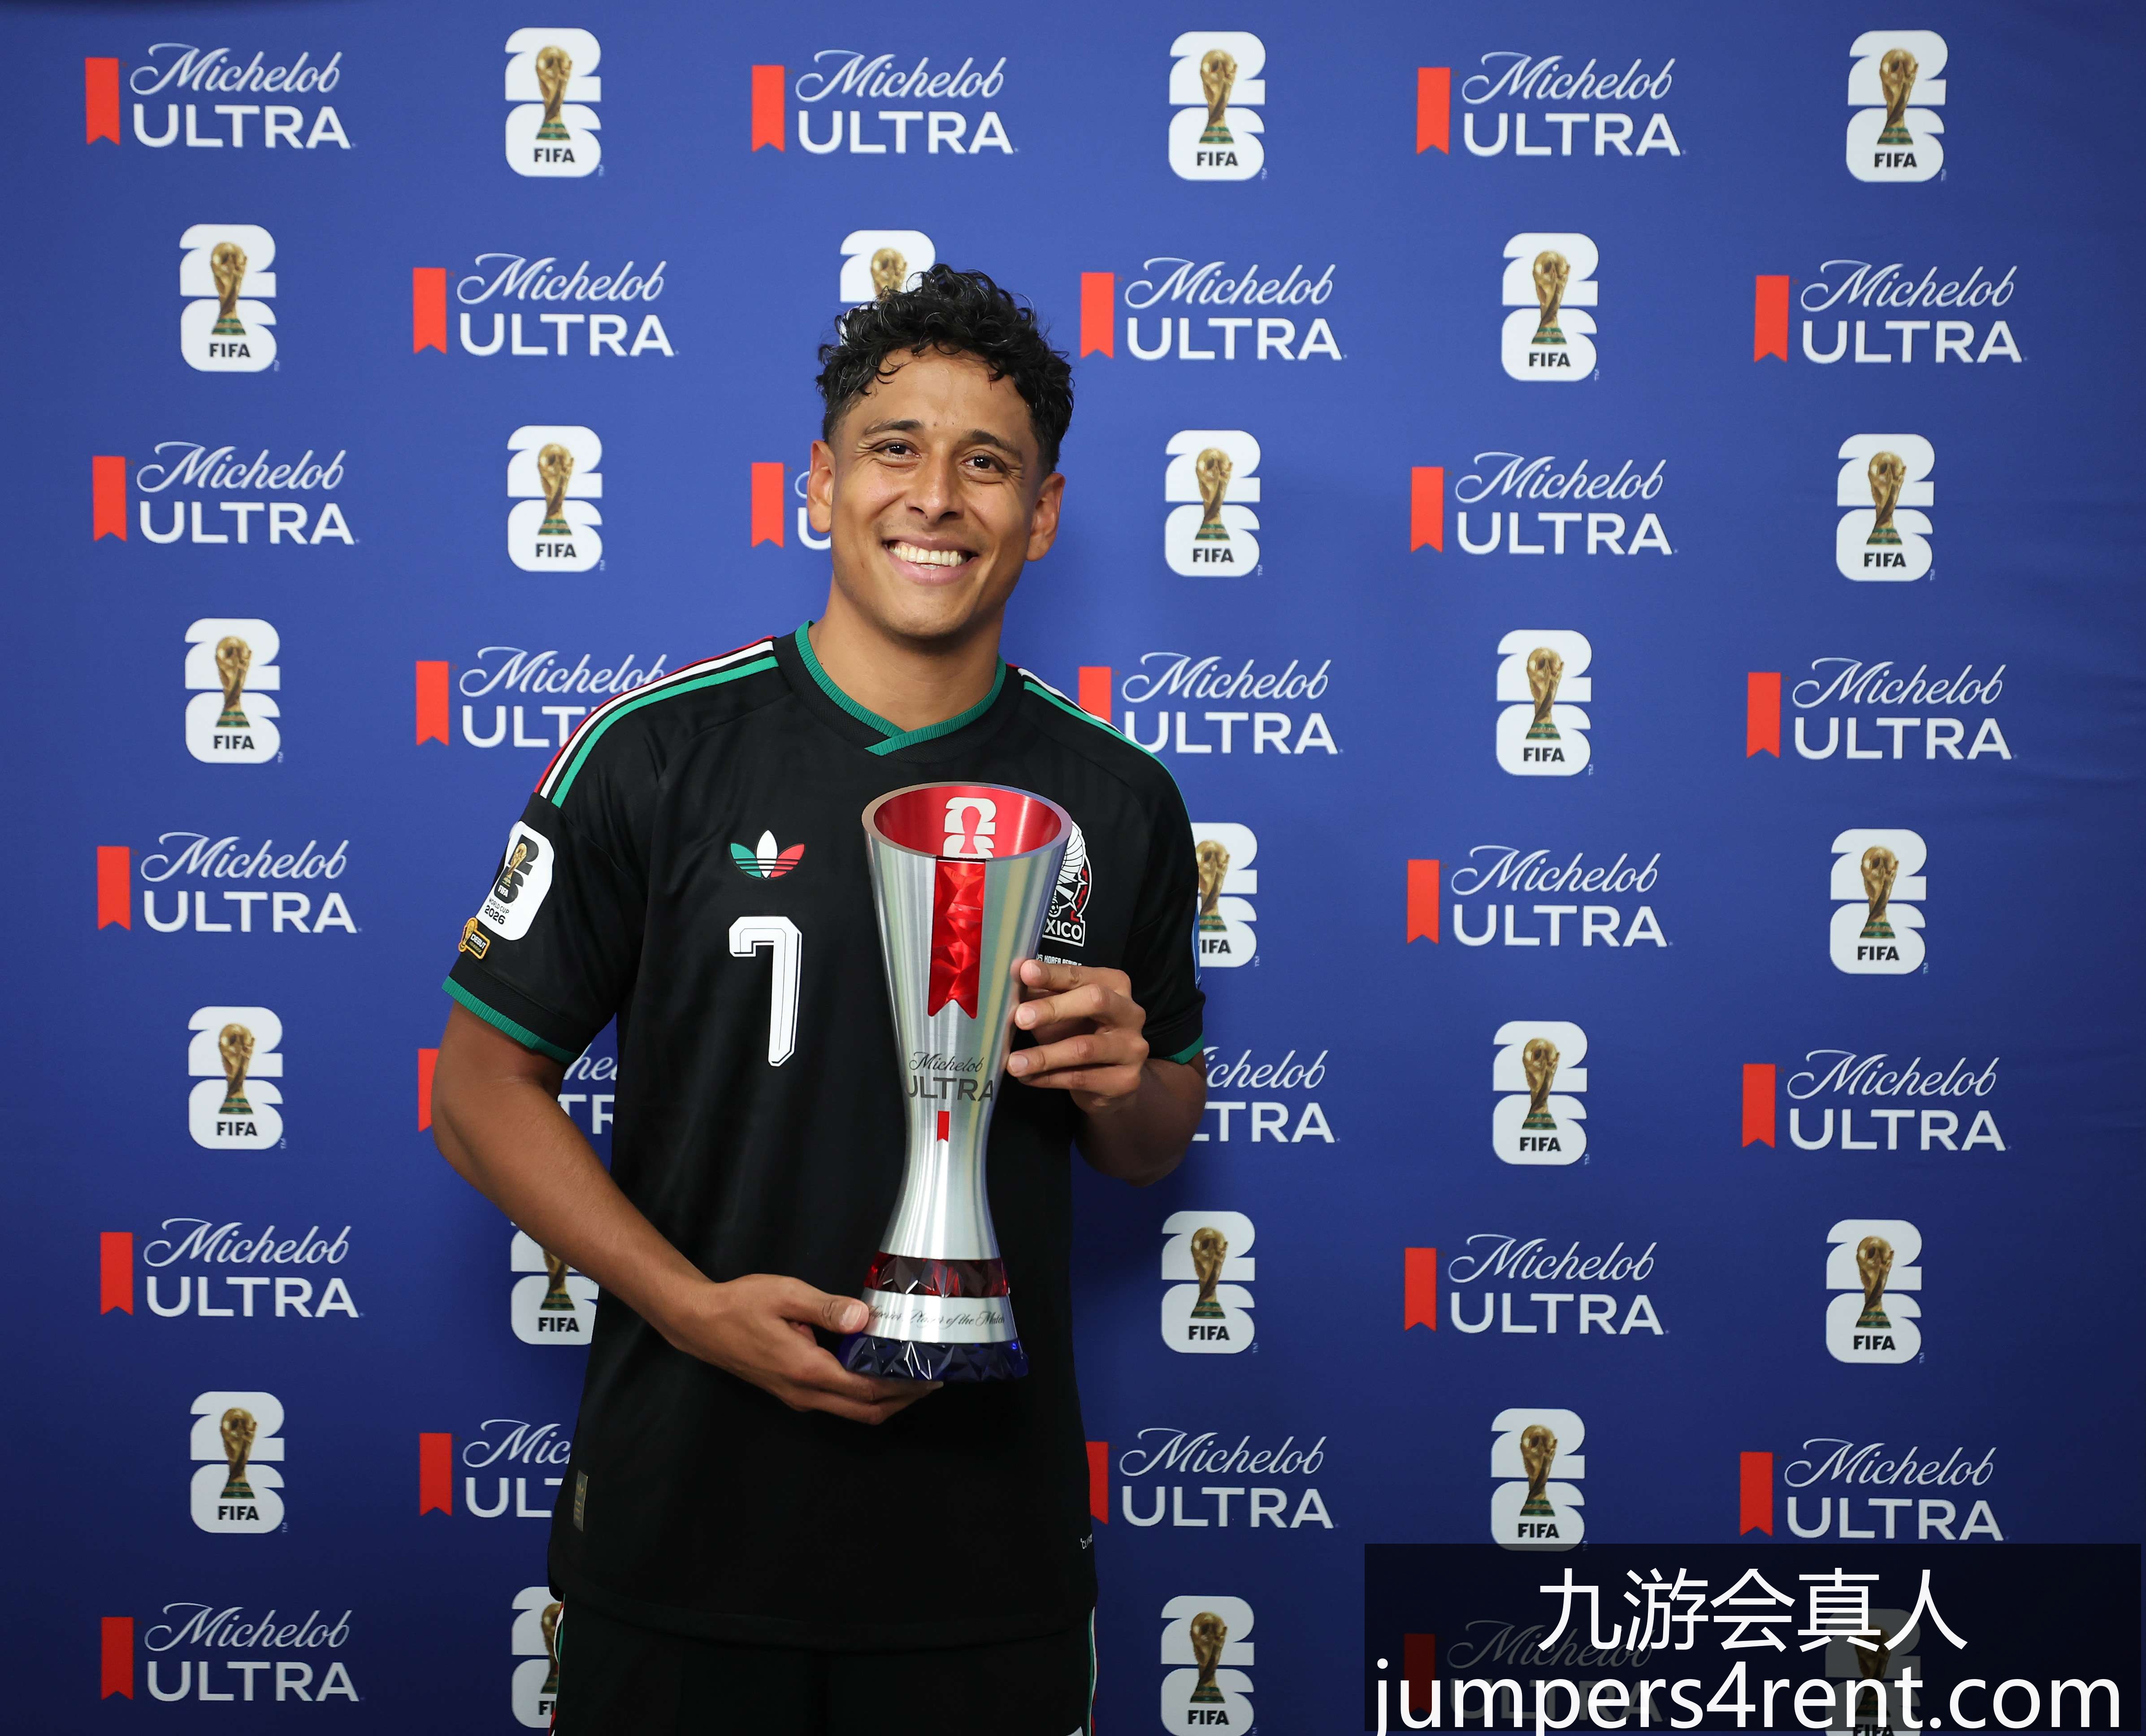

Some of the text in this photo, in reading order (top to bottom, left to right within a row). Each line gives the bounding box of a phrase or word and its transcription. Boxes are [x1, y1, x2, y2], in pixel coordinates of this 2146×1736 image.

[130, 43, 341, 95] Michelob
[796, 50, 1006, 101] Michelob
[1462, 52, 1675, 104] Michelob
[134, 104, 351, 149] ULTRA
[799, 111, 1013, 154] ULTRA
[1464, 113, 1680, 156] ULTRA
[534, 148, 575, 162] FIFA
[1197, 152, 1238, 166] FIFA
[1874, 153, 1917, 167] FIFA
[457, 253, 666, 304] Michelob
[1125, 258, 1335, 308] Michelob
[1801, 260, 2016, 311] Michelob
[210, 343, 250, 357] FIFA
[460, 313, 674, 356] ULTRA
[1127, 317, 1342, 360] ULTRA
[1803, 321, 2022, 364] ULTRA
[1529, 352, 1570, 367] FIFA
[137, 442, 346, 492] Michelob
[1456, 452, 1666, 503] Michelob
[140, 501, 354, 545] ULTRA
[1458, 512, 1672, 555] ULTRA
[536, 543, 576, 557] FIFA
[1193, 548, 1234, 562] FIFA
[1864, 553, 1906, 567] FIFA
[1123, 652, 1331, 703] Michelob
[1793, 658, 2005, 708] Michelob
[214, 735, 254, 749] FIFA
[462, 706, 593, 748] ULT
[1124, 712, 1338, 754] ULTRA
[1795, 717, 2012, 760] ULTRA
[1524, 748, 1565, 762] FIFA
[141, 832, 348, 881] Michelob
[1452, 846, 1660, 895] Michelob
[144, 891, 356, 933] ULTRA
[498, 885, 509, 897] FIFA
[500, 906, 509, 914] CUP
[485, 905, 506, 924] 2026
[1045, 918, 1082, 940] XICO
[1454, 904, 1667, 947] ULTRA
[1200, 939, 1231, 953] IFA
[1858, 946, 1899, 960] FIFA
[729, 916, 802, 1066] 7
[909, 1051, 984, 1072] Michelob
[1203, 1046, 1328, 1089] chelob
[1787, 1050, 1999, 1099] Michelob
[217, 1122, 257, 1136] FIFA
[1192, 1102, 1335, 1143] TRA
[1790, 1108, 2006, 1150] ULTRA
[1520, 1137, 1561, 1151] FIFA
[144, 1218, 351, 1267] Michelob
[1449, 1234, 1656, 1283] Michelob
[147, 1276, 359, 1317] ULTRA
[1451, 1293, 1664, 1335] ULTRA
[538, 1317, 579, 1332] FIFA
[1189, 1326, 1230, 1340] FIFA
[1854, 1336, 1895, 1350] FIFA
[1119, 1428, 1326, 1476] Michelob
[1785, 1438, 1996, 1487] Michelob
[218, 1506, 259, 1520] FIFA
[1122, 1486, 1334, 1528] ULTRA
[1787, 1497, 2003, 1541] ULTRA
[1518, 1523, 1559, 1538] FIFA
[145, 1603, 352, 1651] Michelob
[148, 1661, 359, 1701] ULTRA
[1188, 1710, 1229, 1725] FIFA
